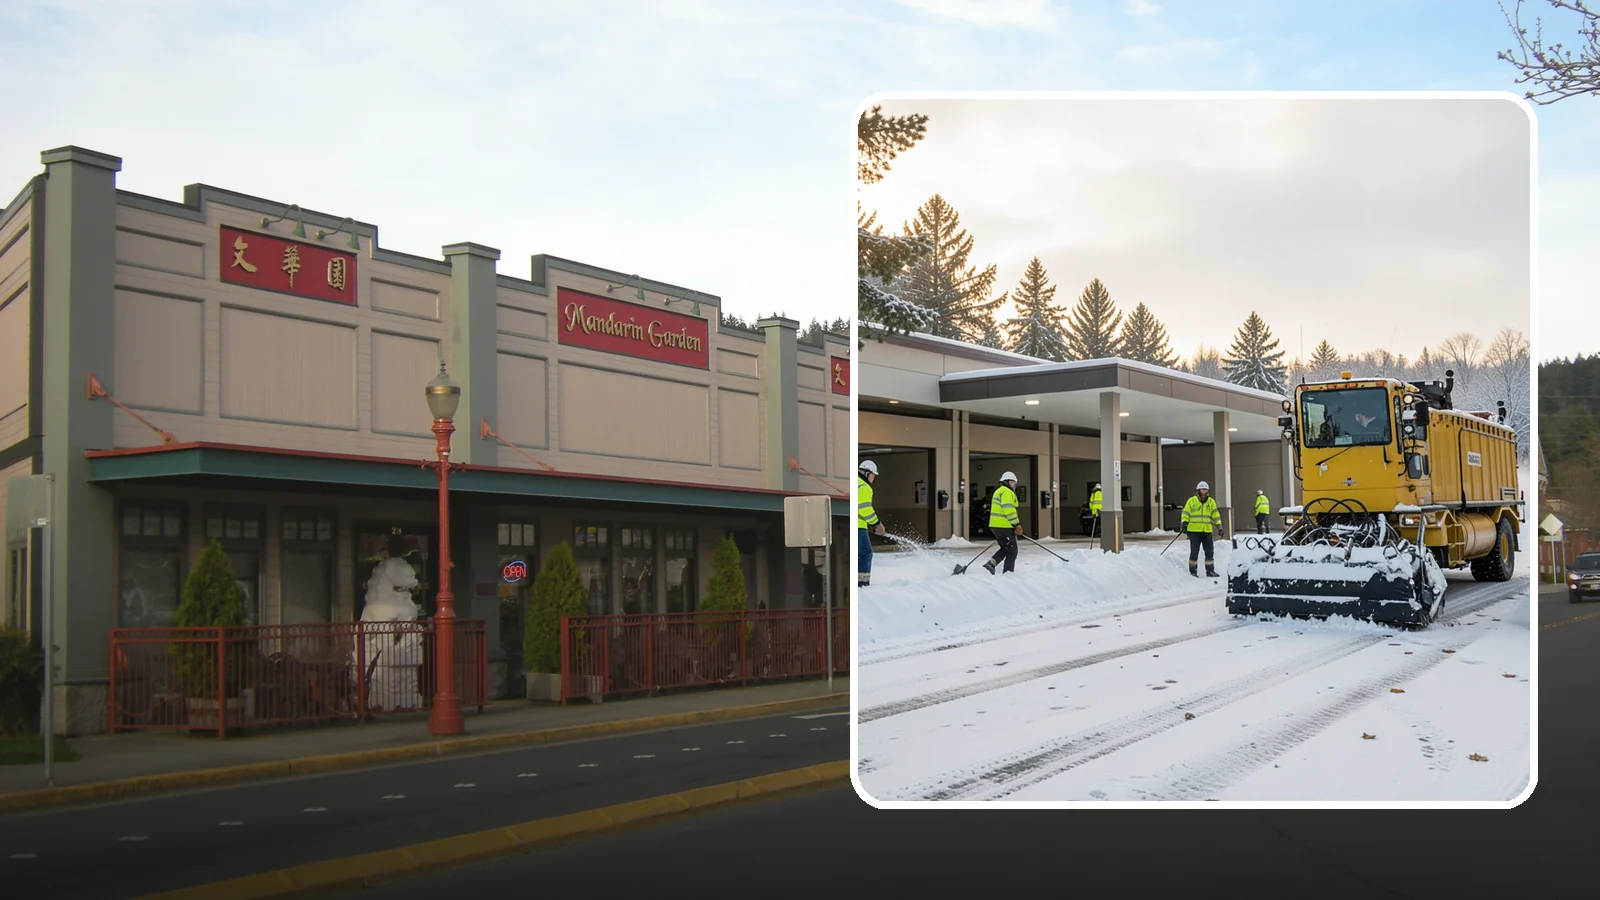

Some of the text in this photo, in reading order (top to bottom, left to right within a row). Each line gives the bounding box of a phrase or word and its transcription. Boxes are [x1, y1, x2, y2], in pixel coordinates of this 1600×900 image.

[231, 235, 346, 291] 文華園
[564, 302, 702, 352] Mandarin Garden
[503, 565, 527, 578] OPEN
